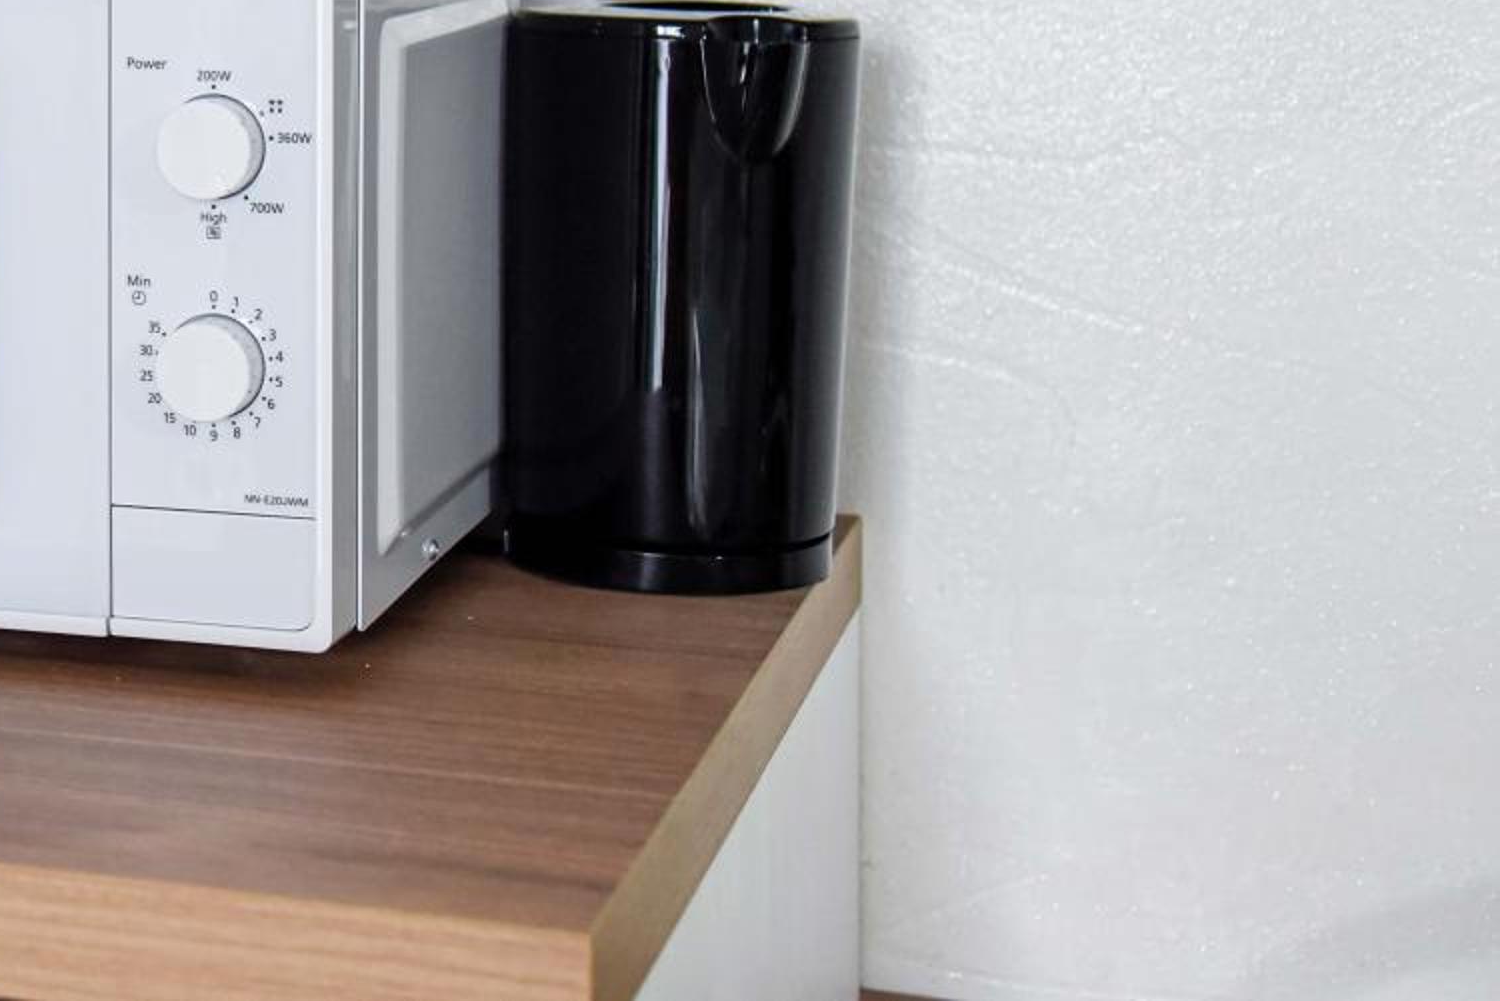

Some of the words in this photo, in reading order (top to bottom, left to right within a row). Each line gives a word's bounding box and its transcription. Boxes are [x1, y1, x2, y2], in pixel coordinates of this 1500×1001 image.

[127, 57, 168, 70] Power
[197, 70, 232, 82] 200W
[277, 131, 312, 144] 360W
[250, 202, 285, 215] 700W
[200, 213, 227, 226] High
[127, 275, 151, 287] Min
[209, 290, 219, 303] 0
[234, 297, 241, 307] 1
[253, 309, 263, 321] 2
[148, 321, 161, 334] 35
[268, 329, 277, 342] 3
[140, 345, 153, 357] 30
[275, 351, 284, 363] 4
[140, 370, 154, 382] 25
[274, 376, 283, 388] 5
[148, 393, 162, 404] 20
[266, 399, 276, 410] 6
[164, 413, 177, 424] 15
[254, 417, 262, 429] 7
[184, 425, 197, 437] 10
[209, 430, 219, 442] 9
[232, 427, 241, 439] 8
